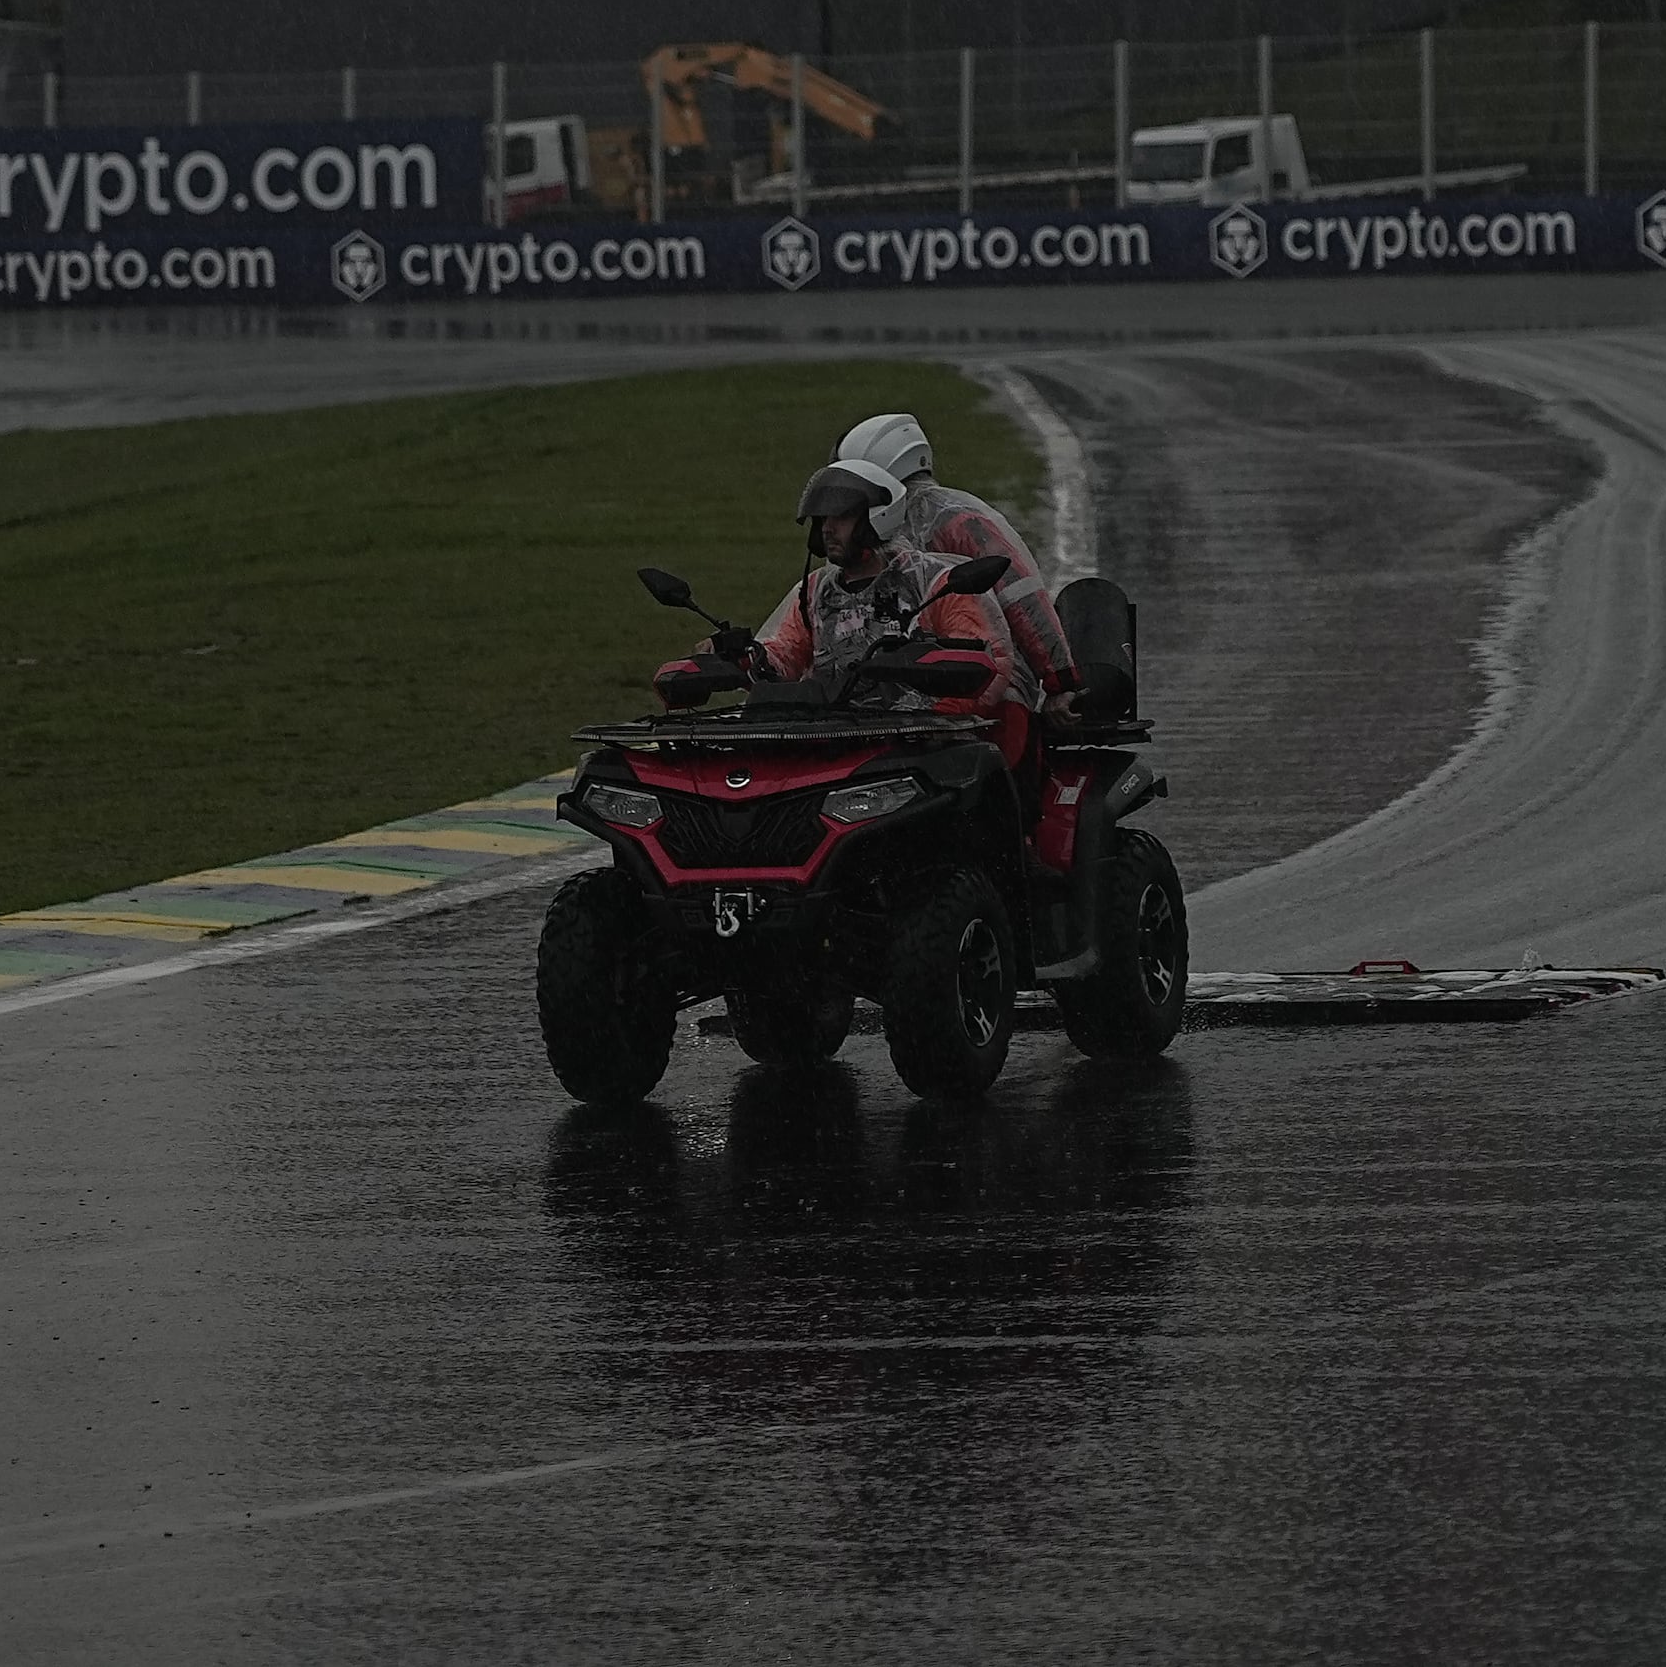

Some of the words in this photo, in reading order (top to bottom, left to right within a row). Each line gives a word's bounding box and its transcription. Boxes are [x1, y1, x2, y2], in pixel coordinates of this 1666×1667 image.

[399, 229, 706, 295] crypto.com
[832, 220, 1151, 282] crypto.com
[1279, 202, 1577, 271] crypto.com
